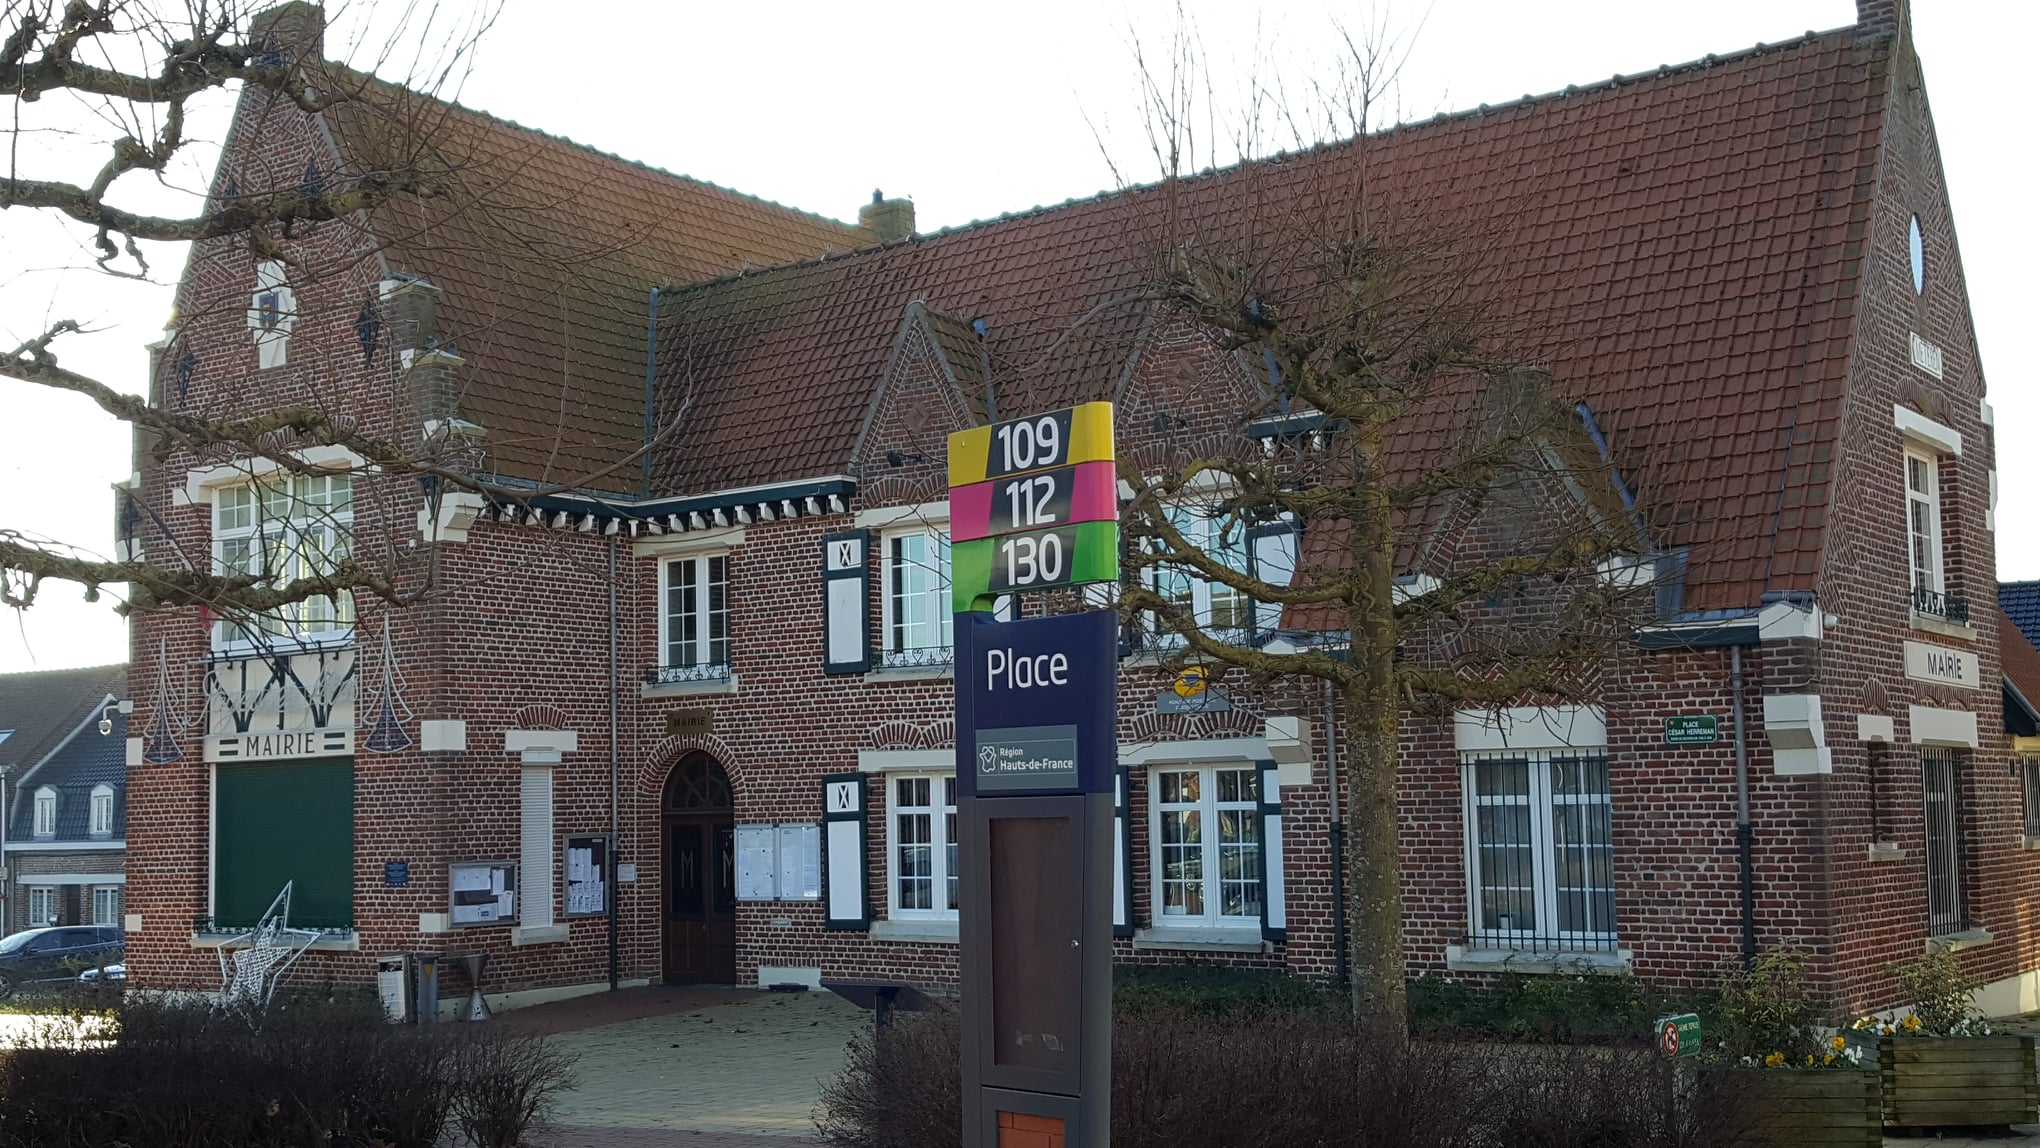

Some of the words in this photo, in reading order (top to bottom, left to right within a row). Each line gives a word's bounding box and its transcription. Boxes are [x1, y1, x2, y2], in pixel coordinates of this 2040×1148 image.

[998, 416, 1059, 472] 109
[1006, 476, 1056, 528] 112
[1002, 533, 1062, 586] 130
[987, 647, 1068, 691] Place
[1927, 650, 1963, 680] MAIRIE
[673, 716, 706, 727] MAIRIE
[1682, 720, 1699, 728] PLACE
[246, 732, 315, 757] MAIRIE
[999, 746, 1024, 758] Région
[1000, 758, 1073, 771] Hauts-de-France
